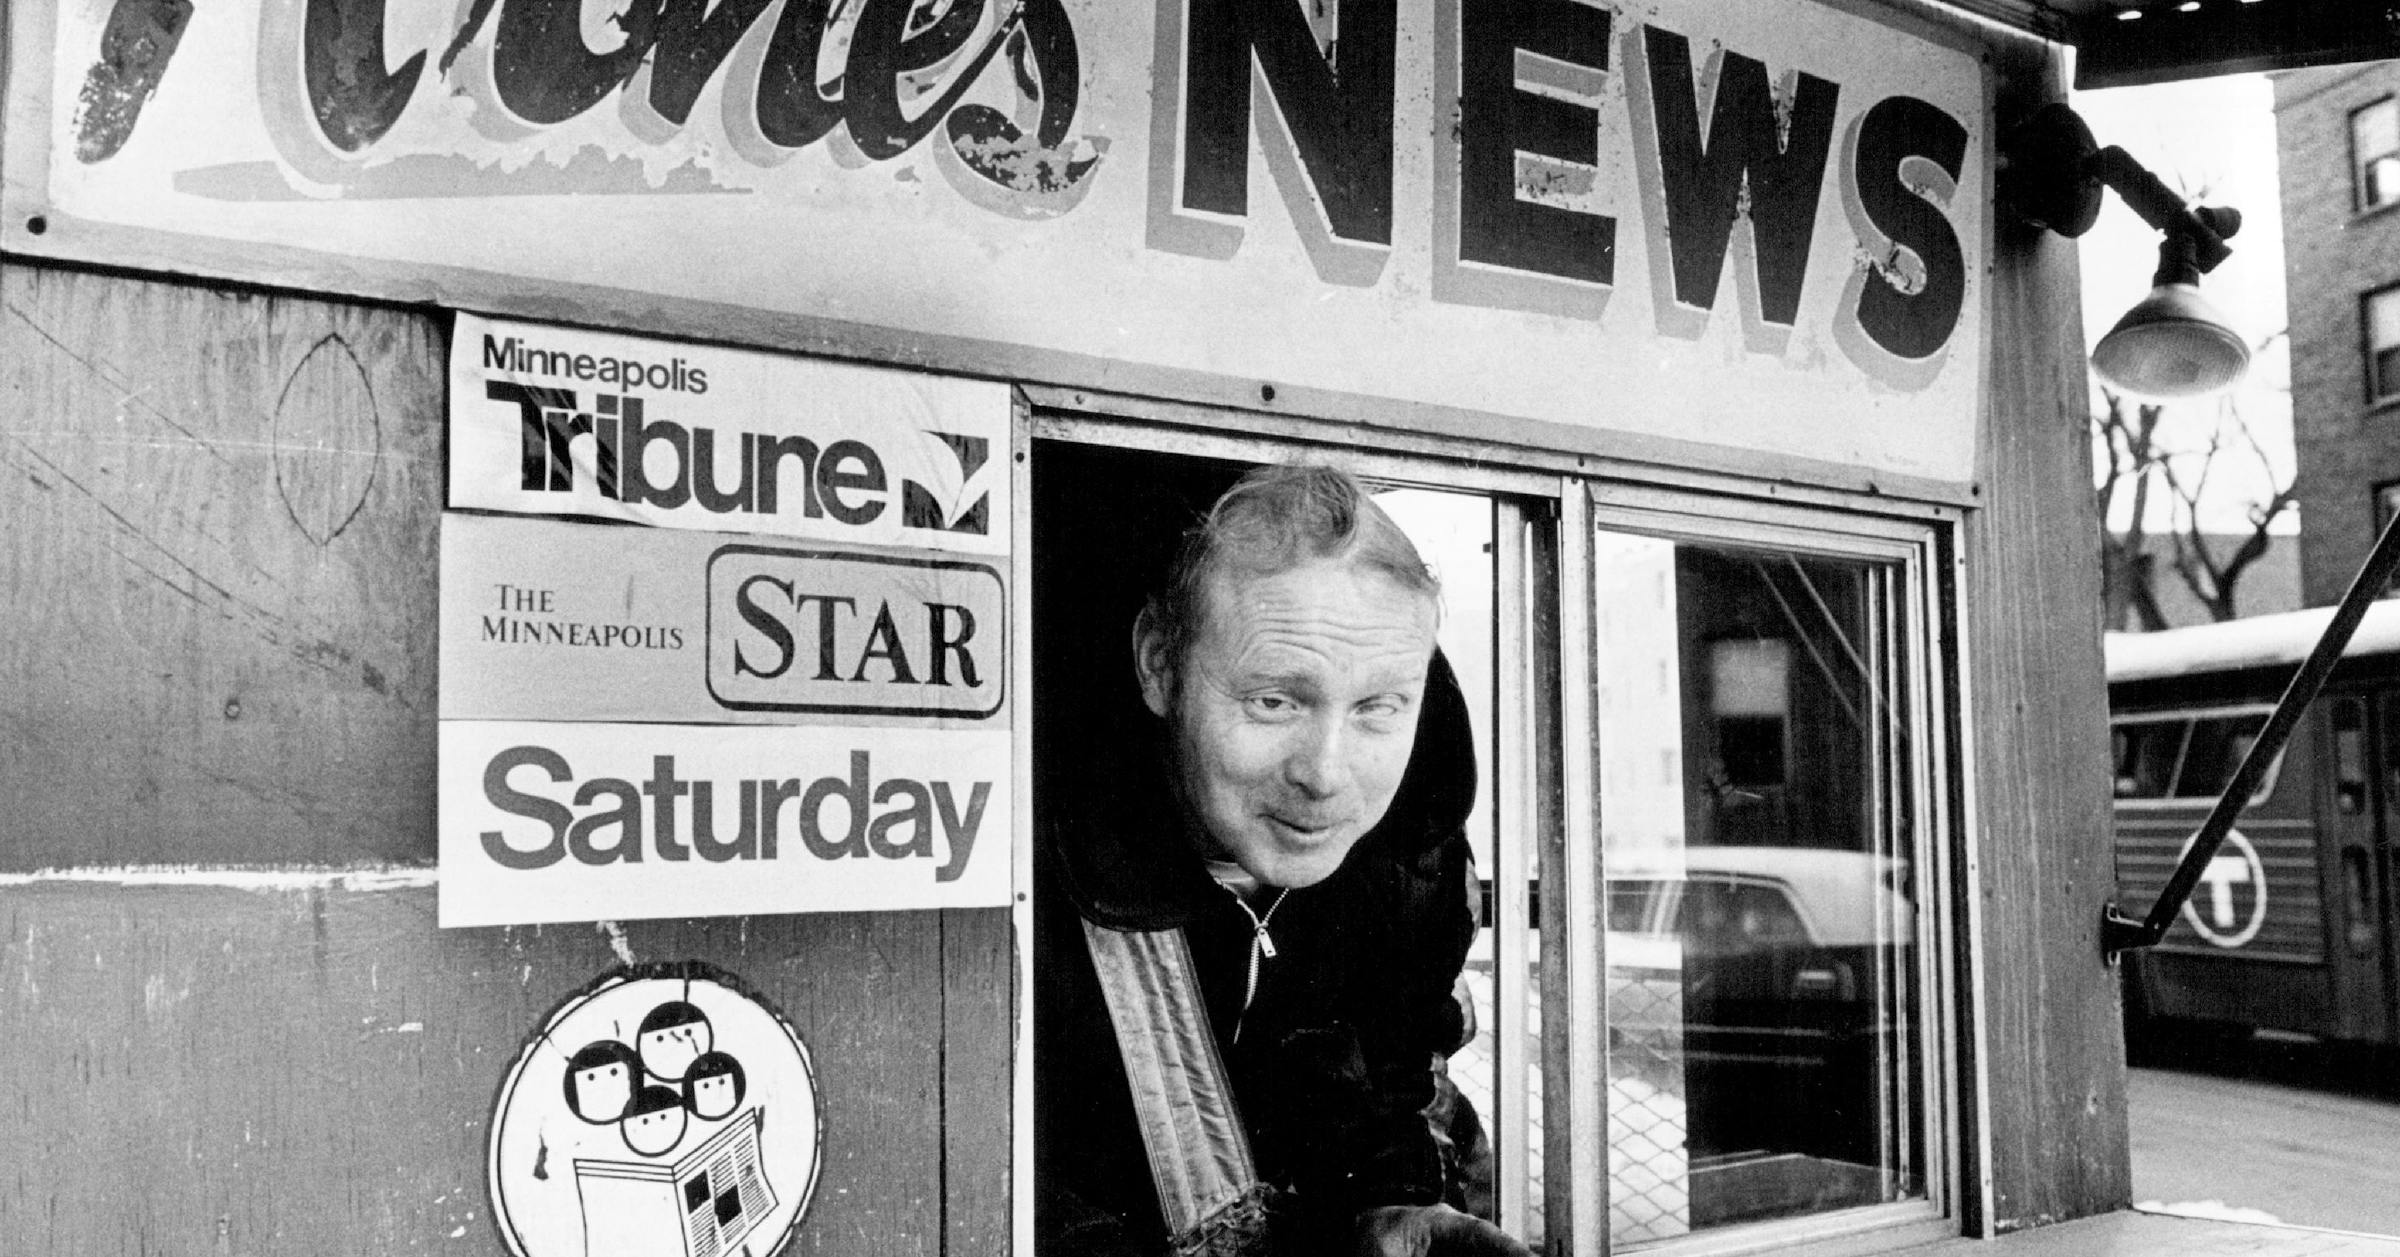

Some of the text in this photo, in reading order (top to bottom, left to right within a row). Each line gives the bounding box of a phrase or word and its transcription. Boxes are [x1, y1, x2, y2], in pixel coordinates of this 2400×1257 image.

[1182, 0, 1968, 360] NEWS
[483, 333, 708, 395] Minneapolis
[485, 378, 888, 526] Tribune
[481, 615, 684, 650] MINNEAPOLIS
[495, 584, 555, 613] THE
[734, 574, 984, 689] STAR
[479, 745, 993, 883] Saturday
[2200, 855, 2250, 928] T
